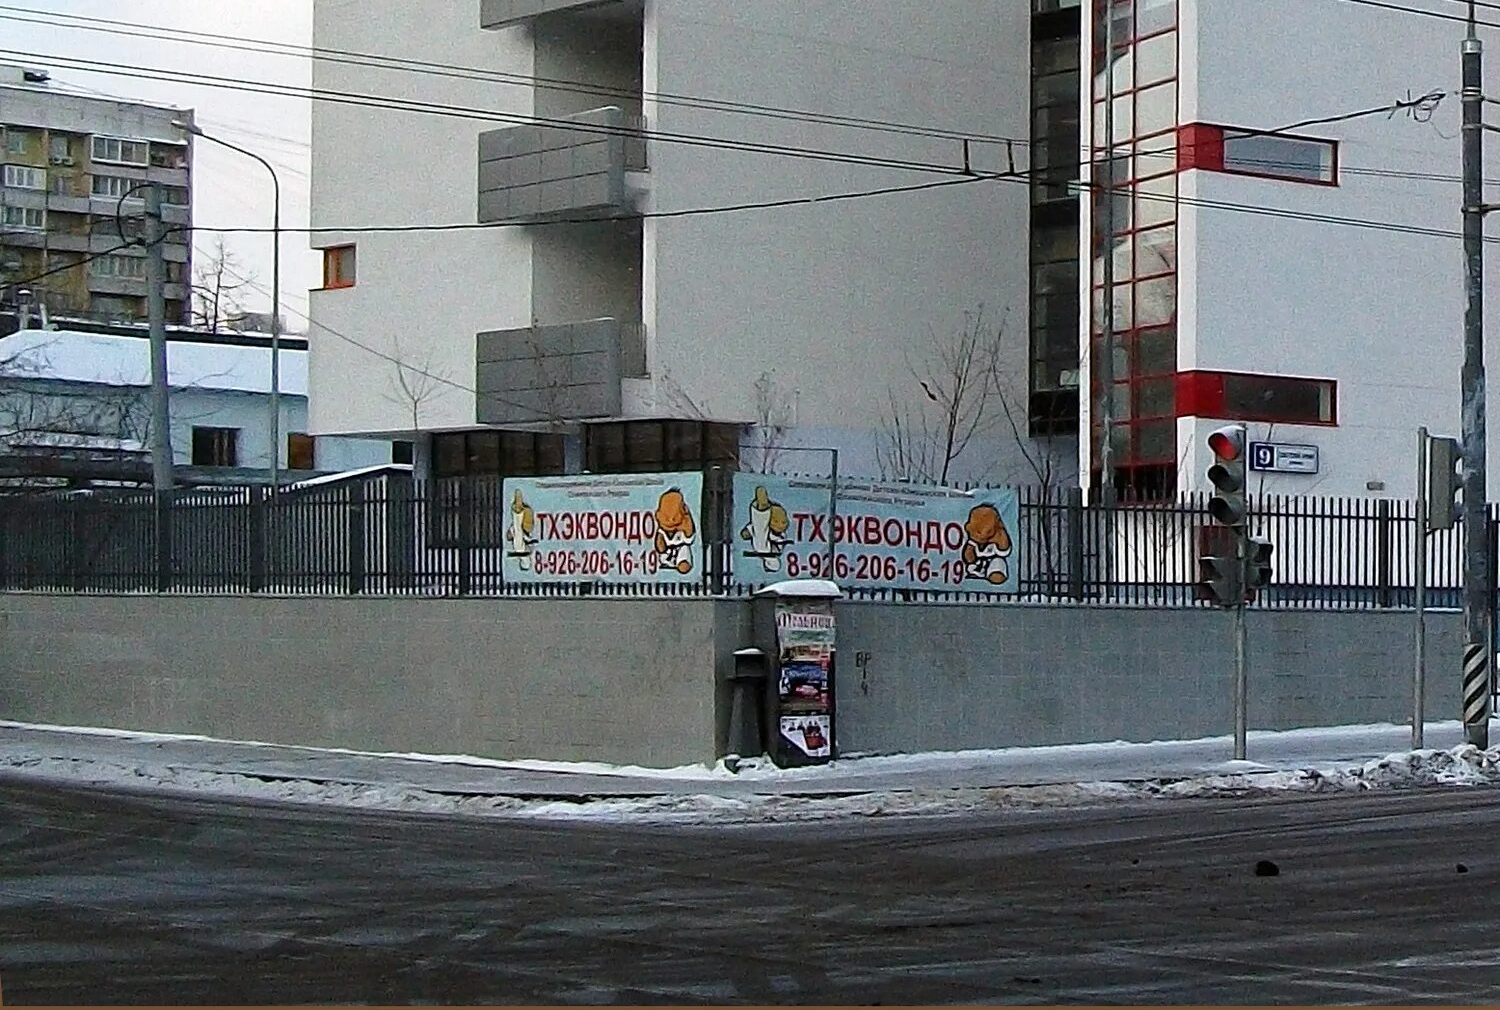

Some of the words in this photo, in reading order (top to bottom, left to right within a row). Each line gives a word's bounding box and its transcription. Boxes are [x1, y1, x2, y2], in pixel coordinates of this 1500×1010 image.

[1259, 448, 1271, 465] 9
[536, 511, 656, 545] ТХЭКВОНДО
[792, 513, 964, 554] ТХЭКВОНДО
[534, 550, 658, 575] 8-926-206-16-19
[786, 551, 965, 585] 8-926-206-16-19
